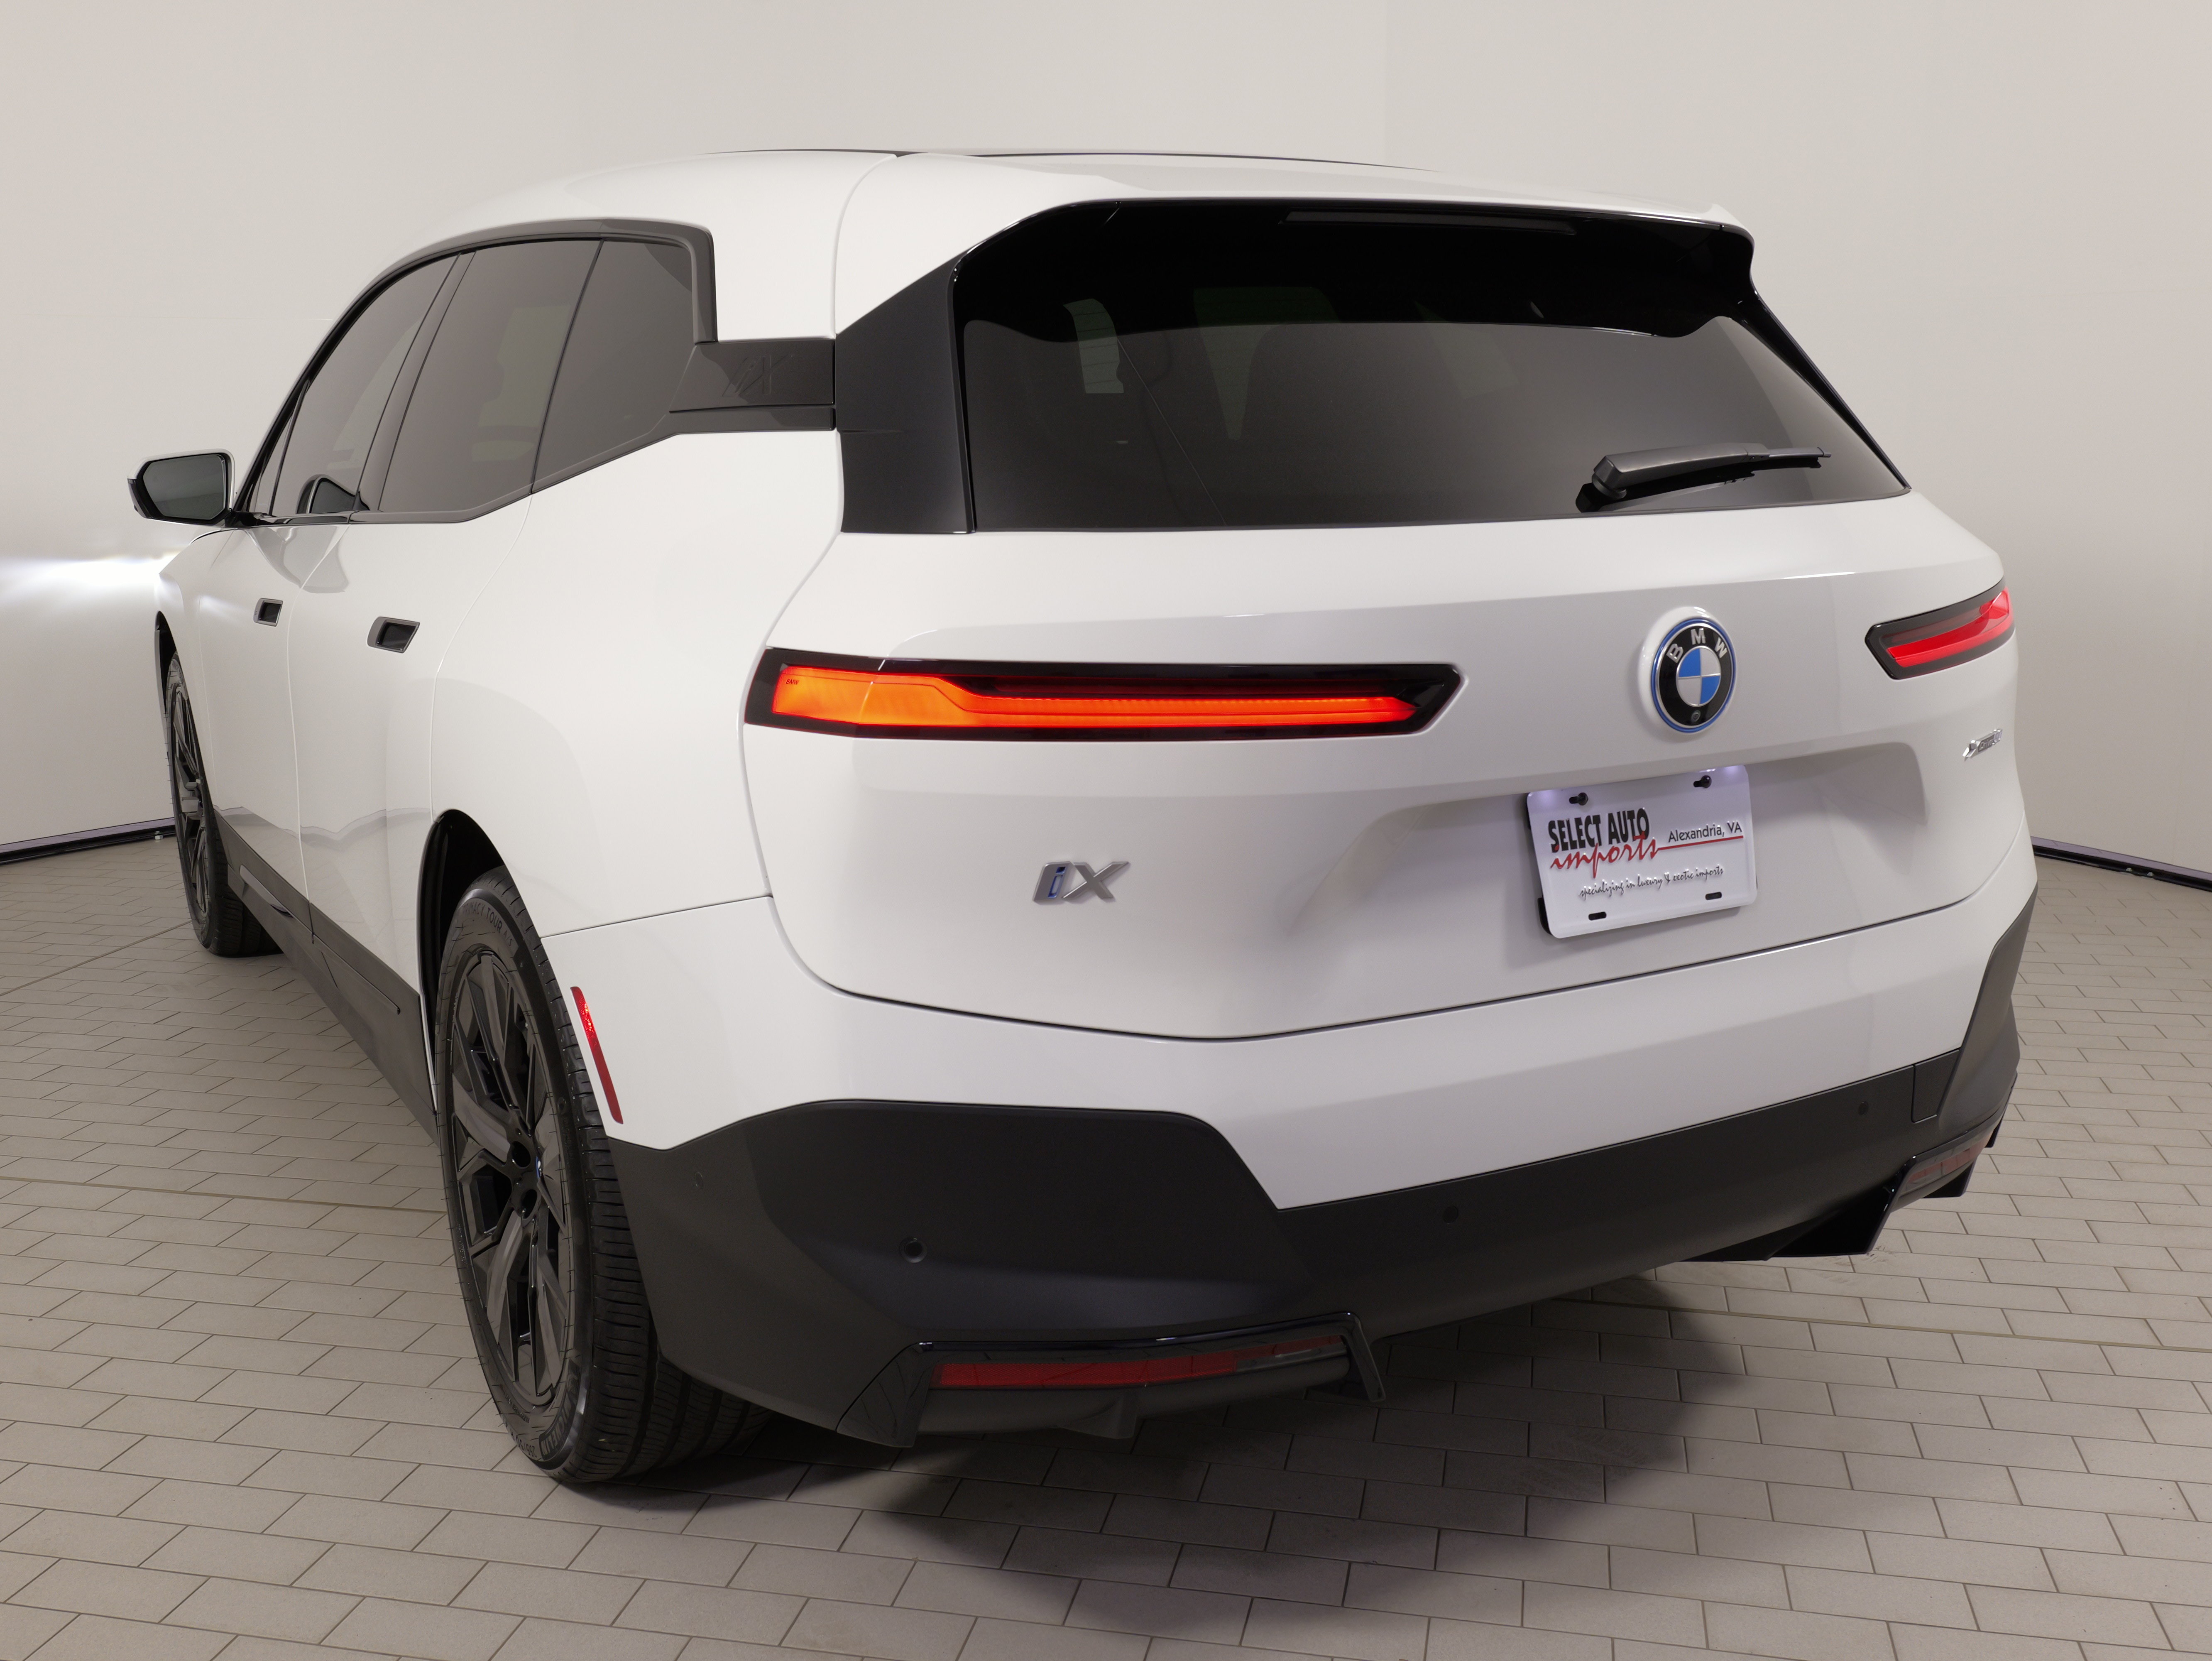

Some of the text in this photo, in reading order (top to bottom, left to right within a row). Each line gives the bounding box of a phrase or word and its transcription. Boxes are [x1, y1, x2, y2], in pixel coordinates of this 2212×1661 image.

[1666, 628, 1728, 663] BMW
[1548, 808, 1649, 853] SELECT AUTO
[1550, 822, 1742, 878] imports Alexandria, VA
[1033, 861, 1129, 902] iX
[1580, 865, 1723, 899] specializing in luxury & exotic imports
[486, 907, 503, 933] TOUR
